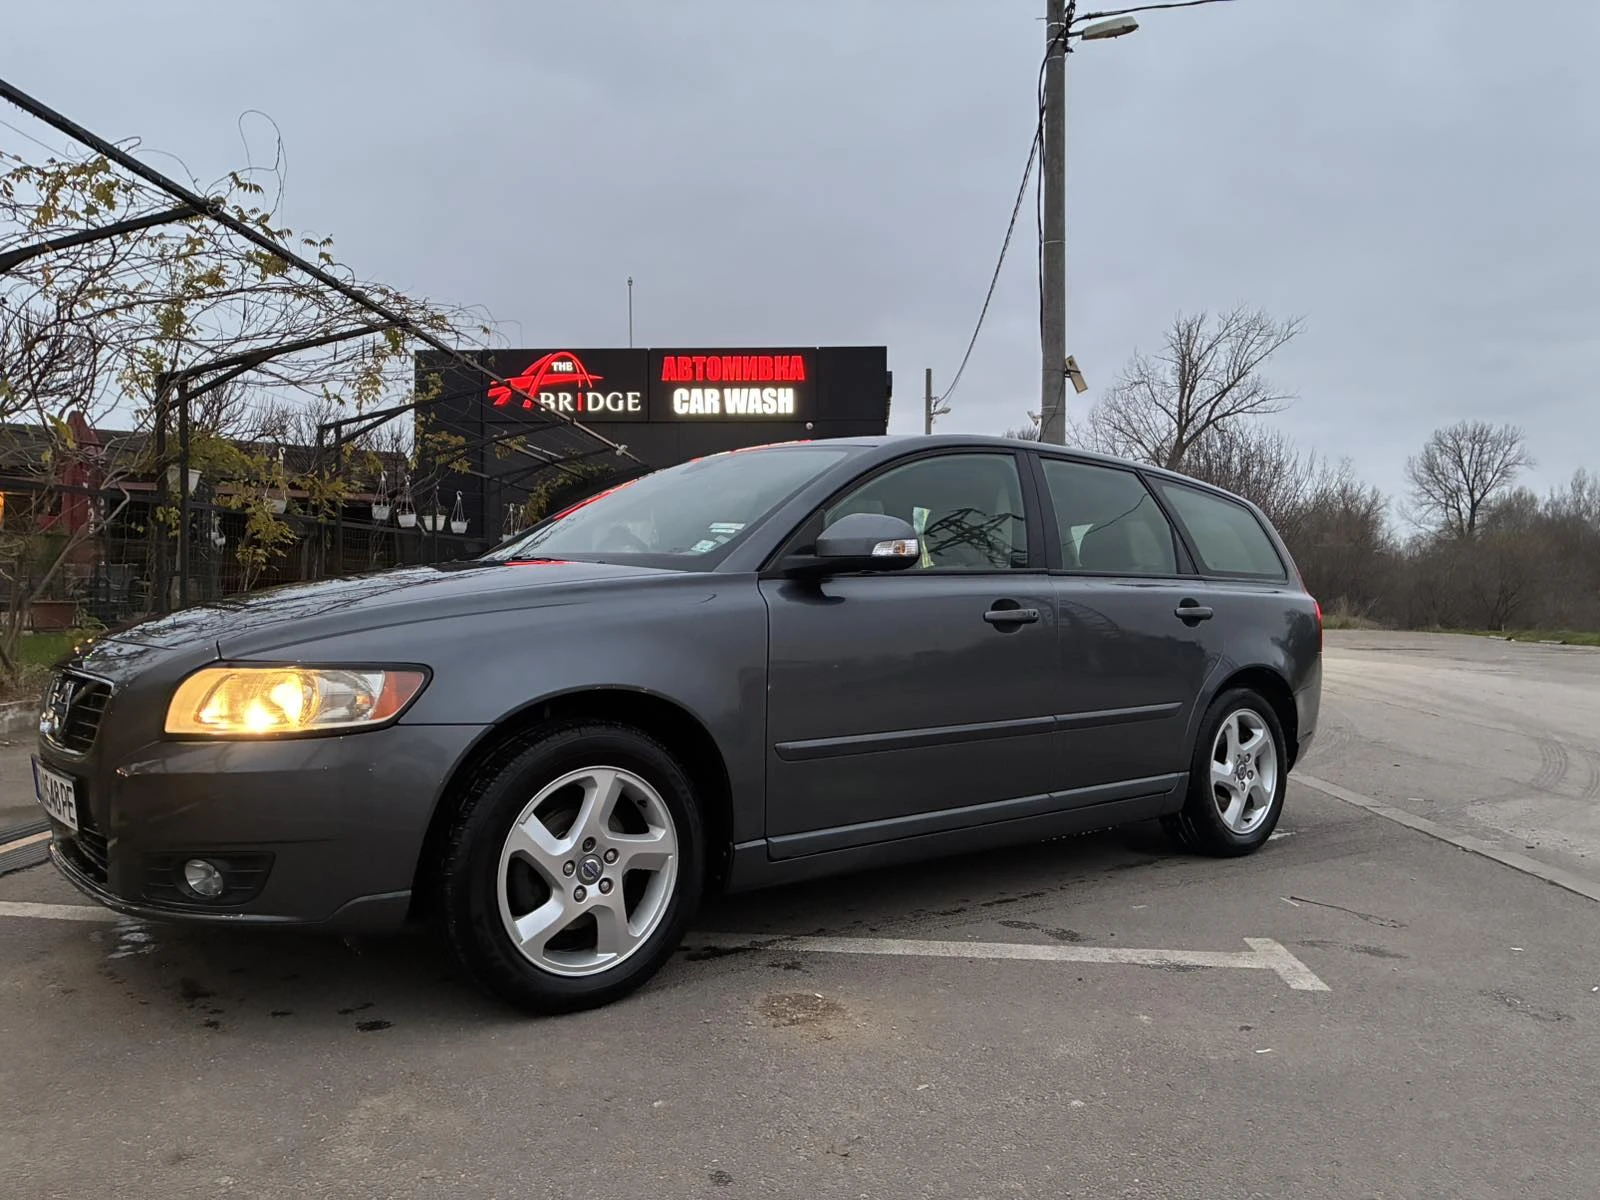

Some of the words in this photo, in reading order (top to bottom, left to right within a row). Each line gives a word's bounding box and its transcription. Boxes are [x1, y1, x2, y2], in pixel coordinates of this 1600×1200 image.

[661, 355, 805, 381] АВТОМИВКА
[539, 392, 641, 412] BRIDGE
[673, 388, 720, 415] CAR
[723, 388, 795, 415] WASH
